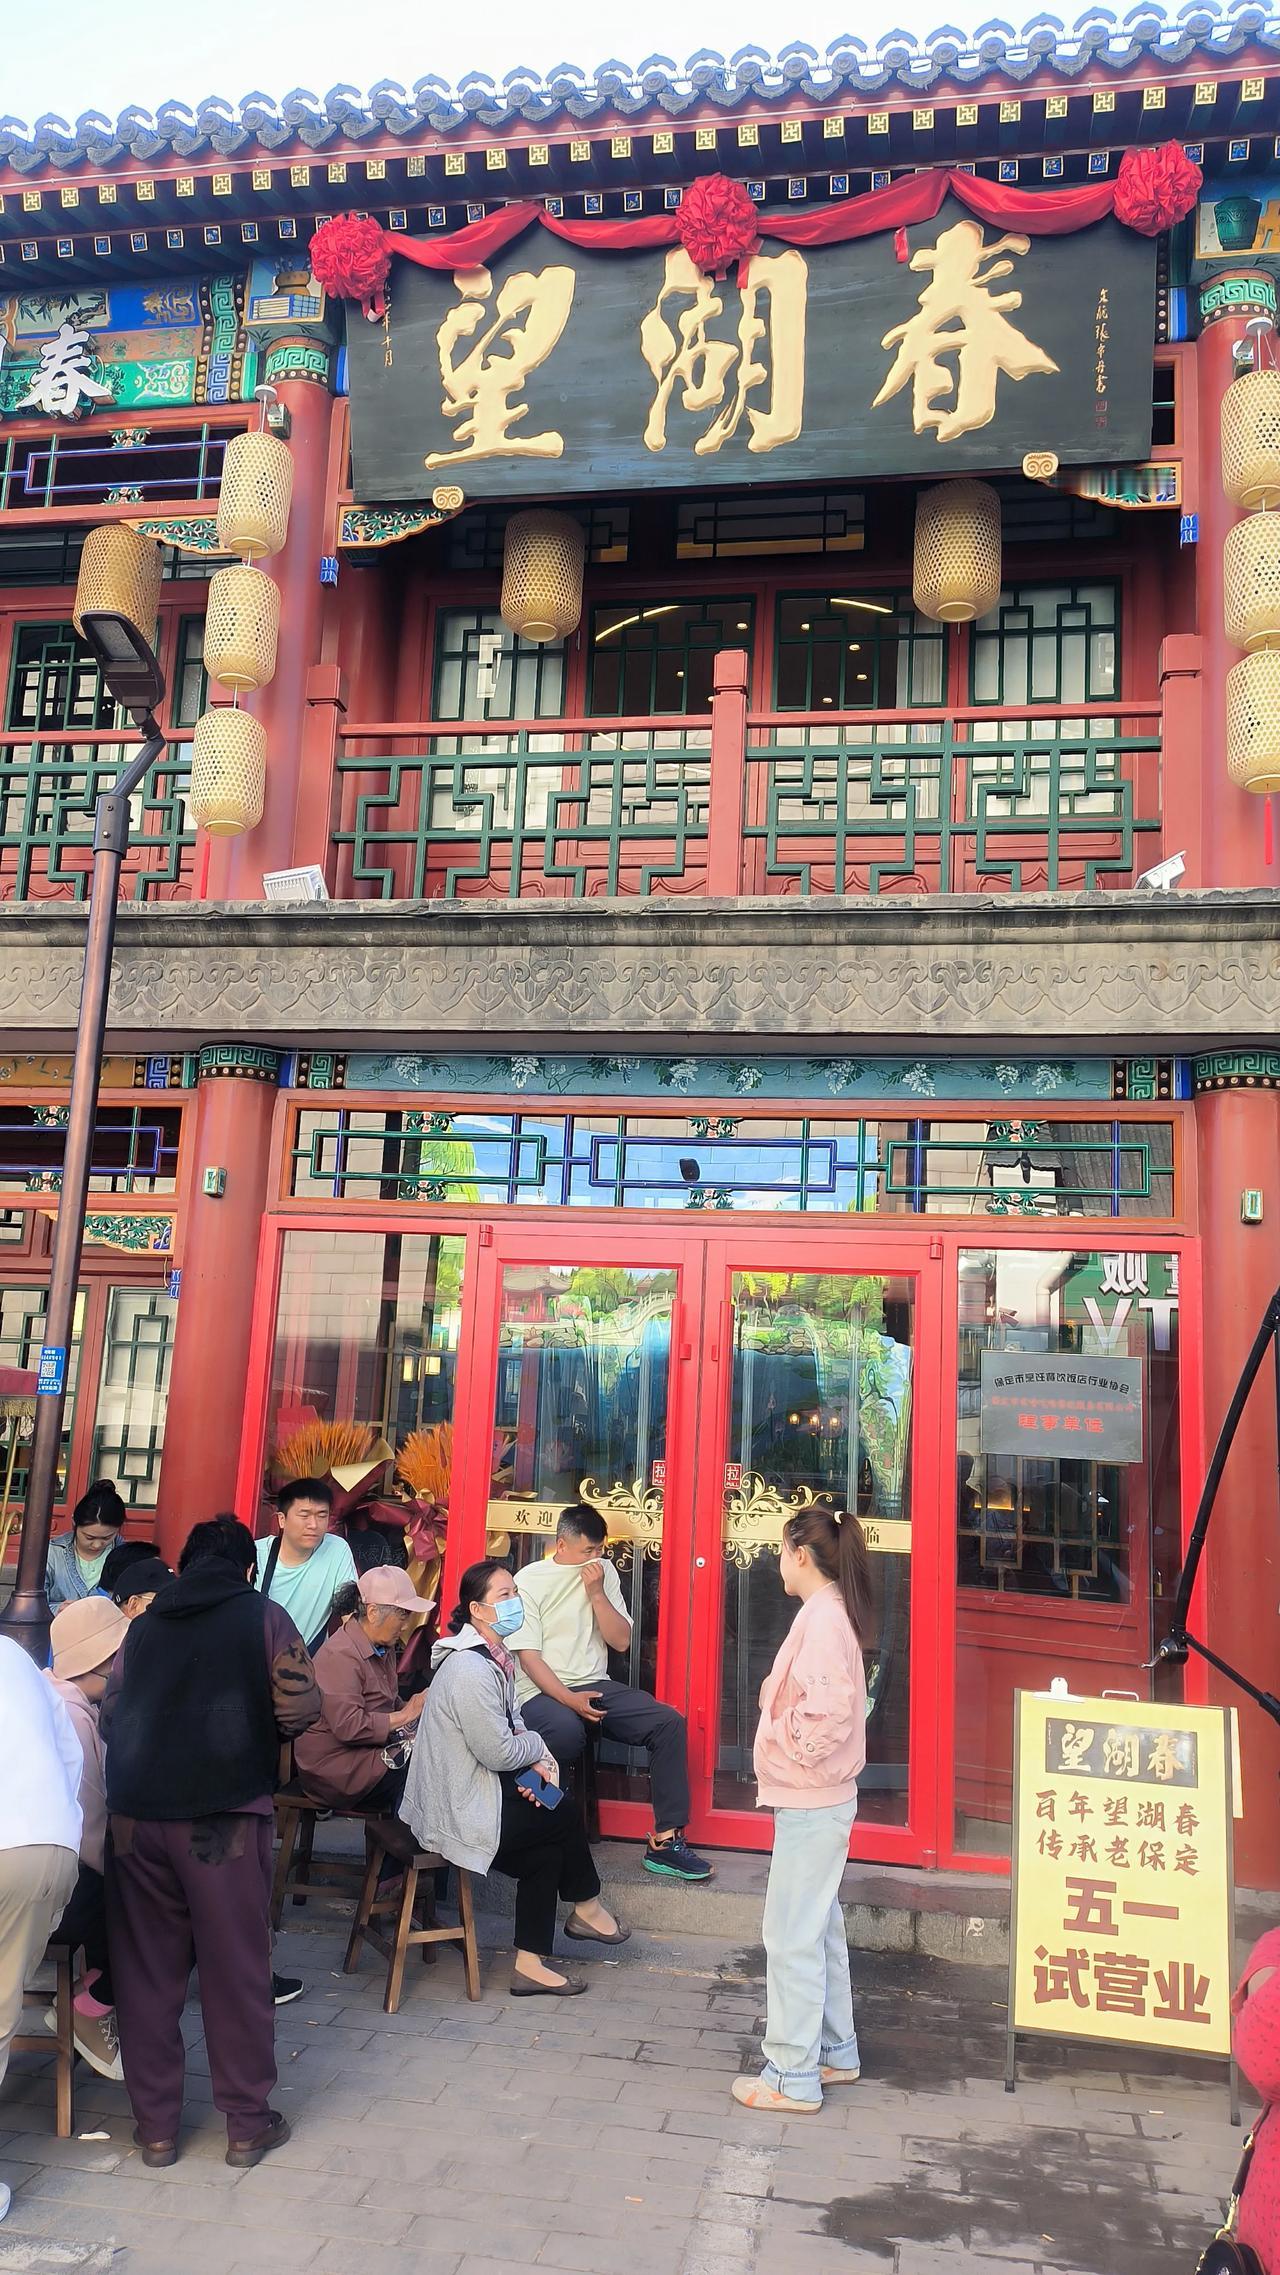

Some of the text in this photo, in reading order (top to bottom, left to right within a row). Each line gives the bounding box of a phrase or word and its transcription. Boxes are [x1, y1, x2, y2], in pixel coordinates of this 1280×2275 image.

[424, 219, 1060, 470] 望湖春
[0, 323, 112, 415] 春
[1018, 1413, 1104, 1433] 理事单位
[655, 1463, 666, 1478] 拉
[727, 1466, 740, 1481] 拉
[514, 1509, 553, 1528] 欢迎
[1058, 1723, 1184, 1781] 望湖春
[1035, 1789, 1201, 1837] 百年望湖春
[1036, 1829, 1201, 1876] 传承老保定
[1063, 1876, 1180, 1936] 五一
[1033, 1944, 1211, 2025] 试营业
